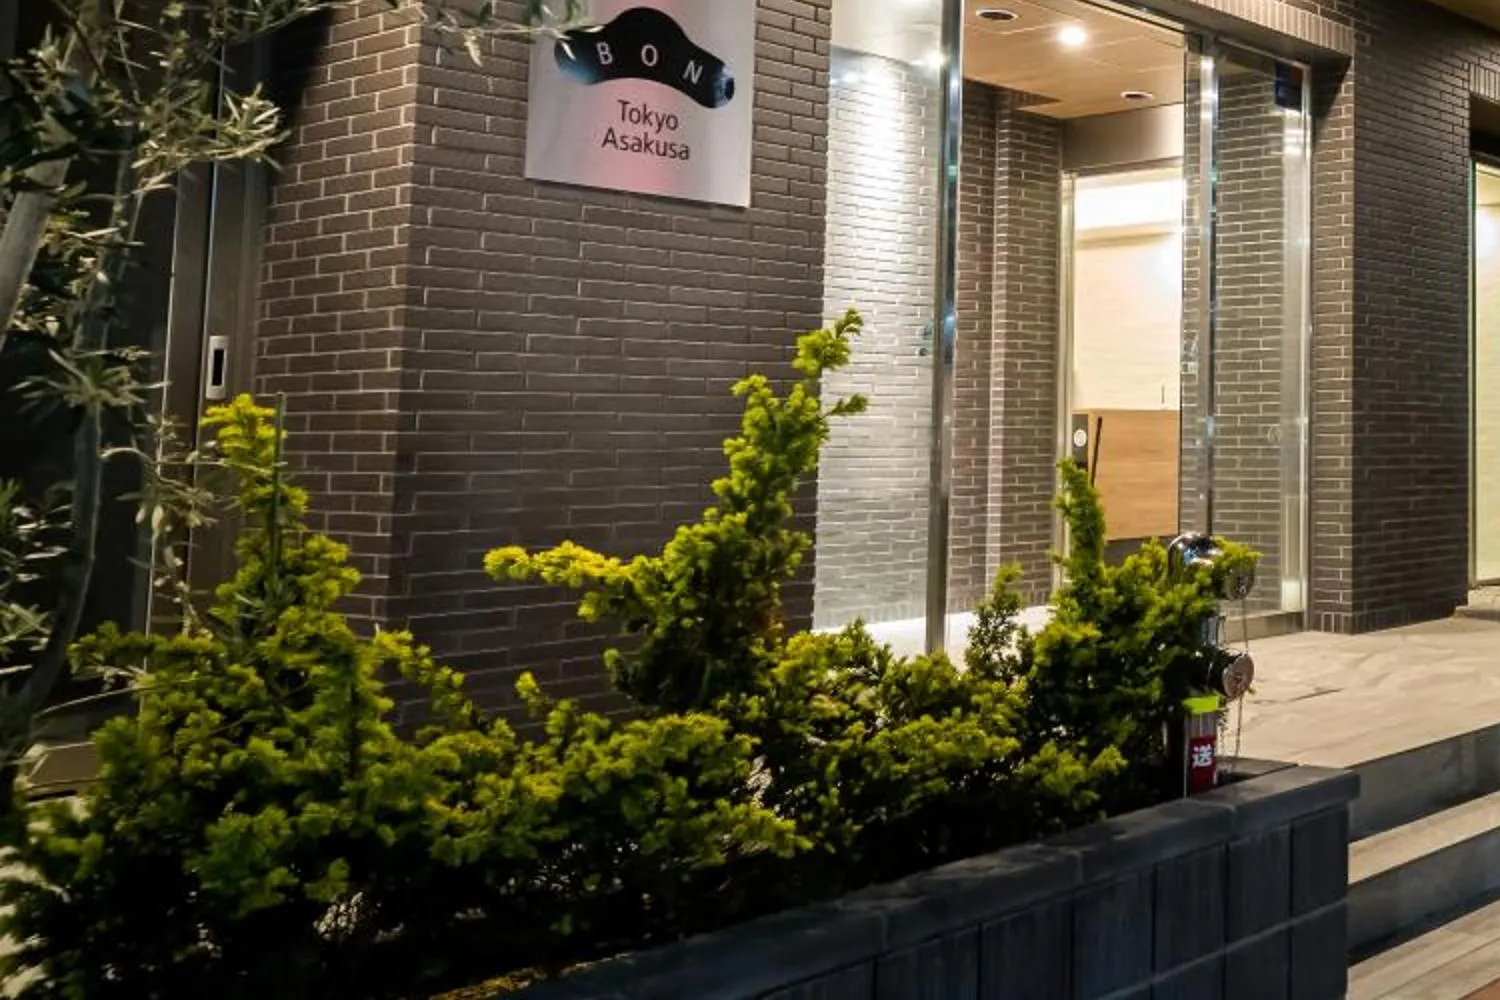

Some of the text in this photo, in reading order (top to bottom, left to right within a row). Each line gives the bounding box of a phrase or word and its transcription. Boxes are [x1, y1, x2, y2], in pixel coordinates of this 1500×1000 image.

[596, 41, 703, 84] BON
[617, 99, 679, 134] Tokyo
[601, 126, 690, 160] Asakusa
